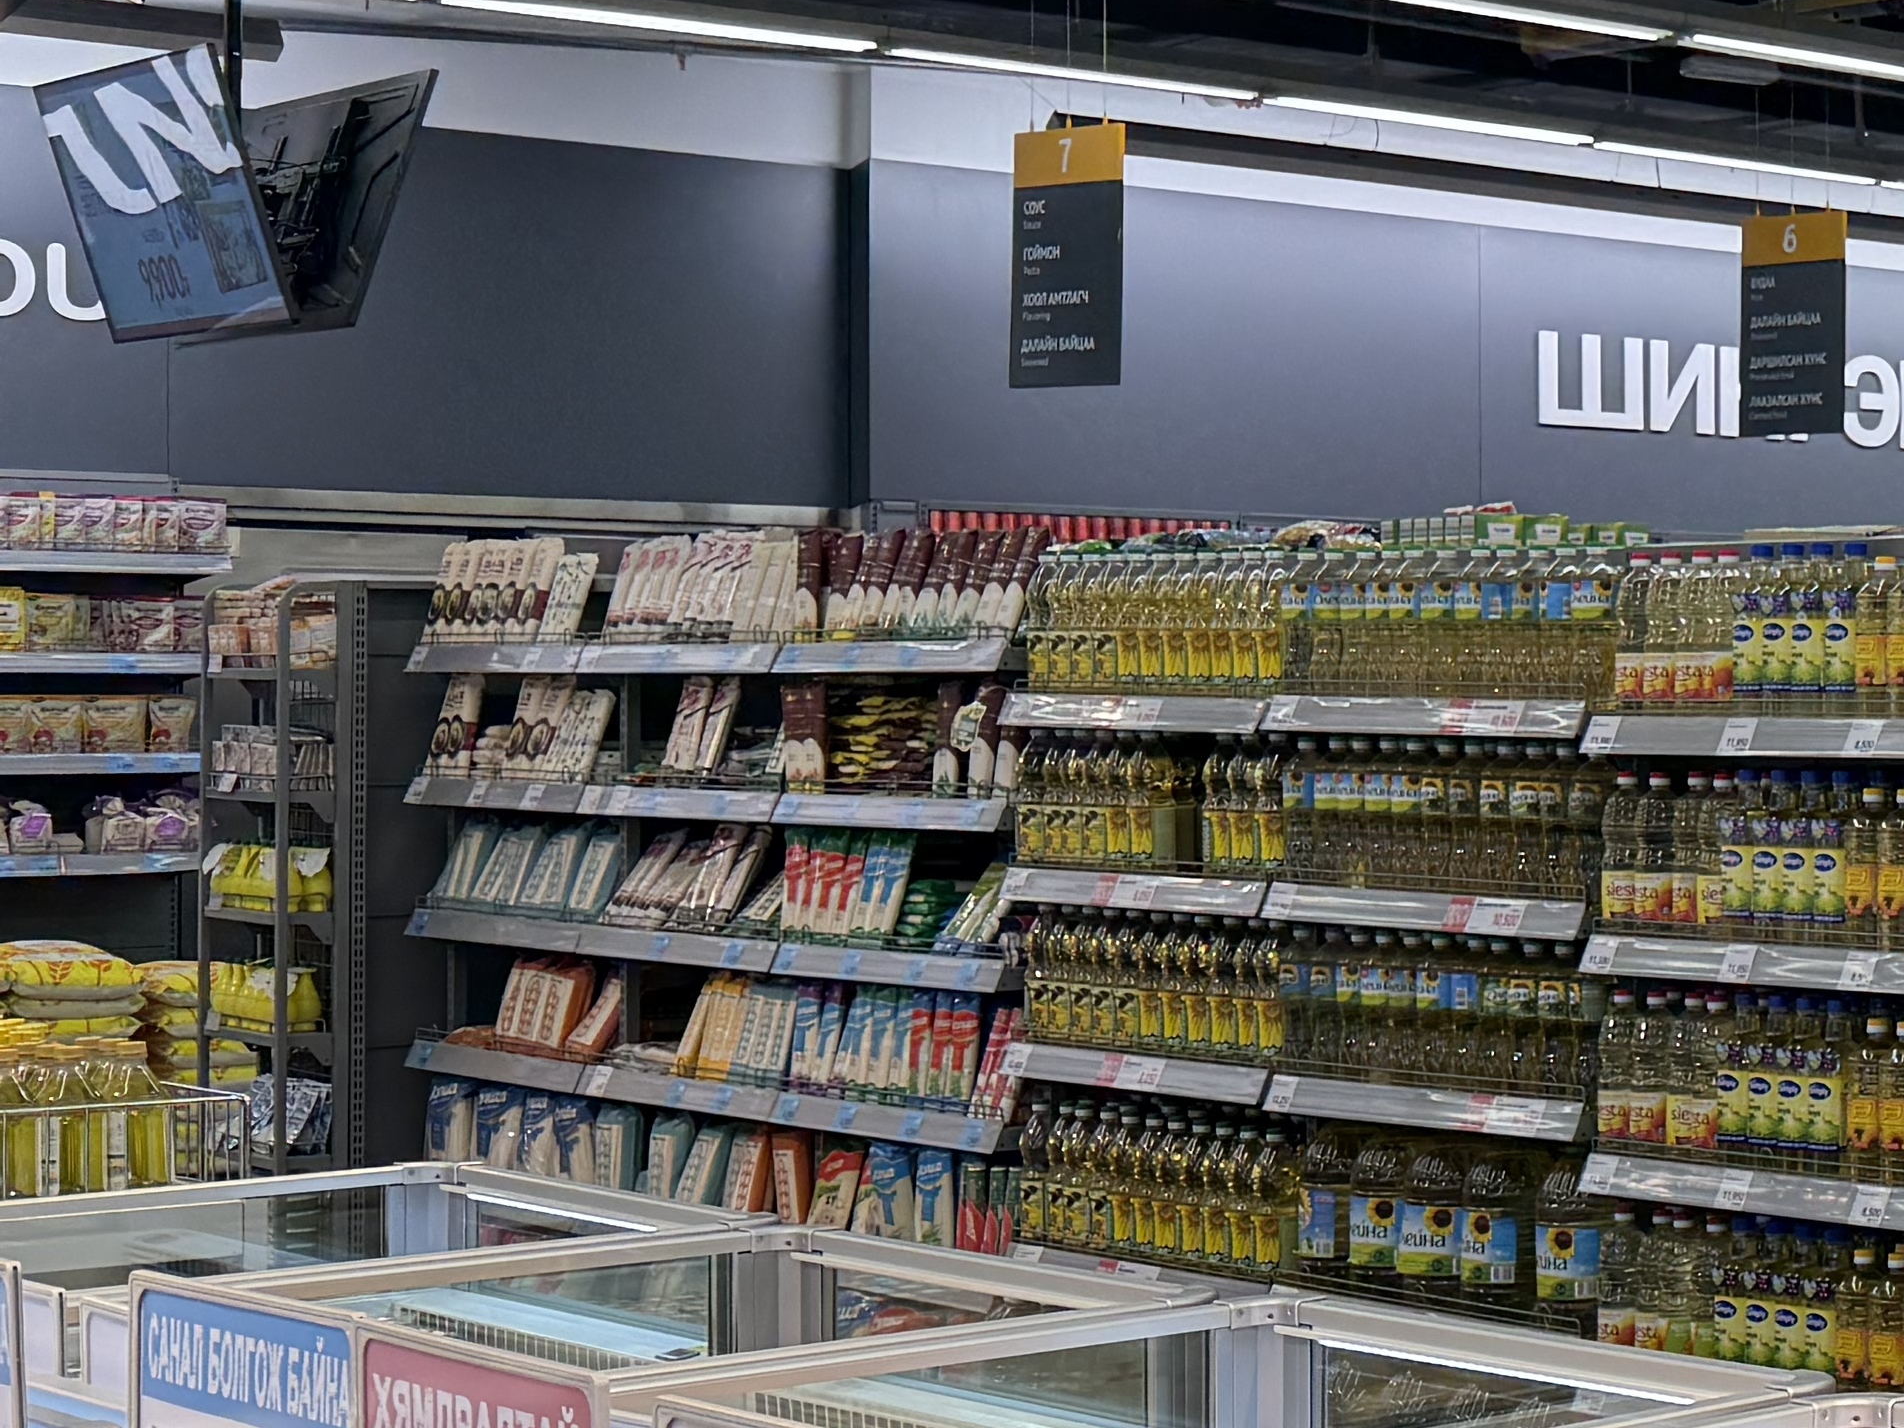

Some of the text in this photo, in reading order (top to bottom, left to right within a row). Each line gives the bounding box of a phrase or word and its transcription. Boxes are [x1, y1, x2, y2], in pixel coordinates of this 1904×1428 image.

[1059, 138, 1072, 172] 7
[1782, 223, 1797, 253] 6
[147, 1311, 203, 1393] САНАЛ
[207, 1326, 284, 1411] БОЛГОЖ
